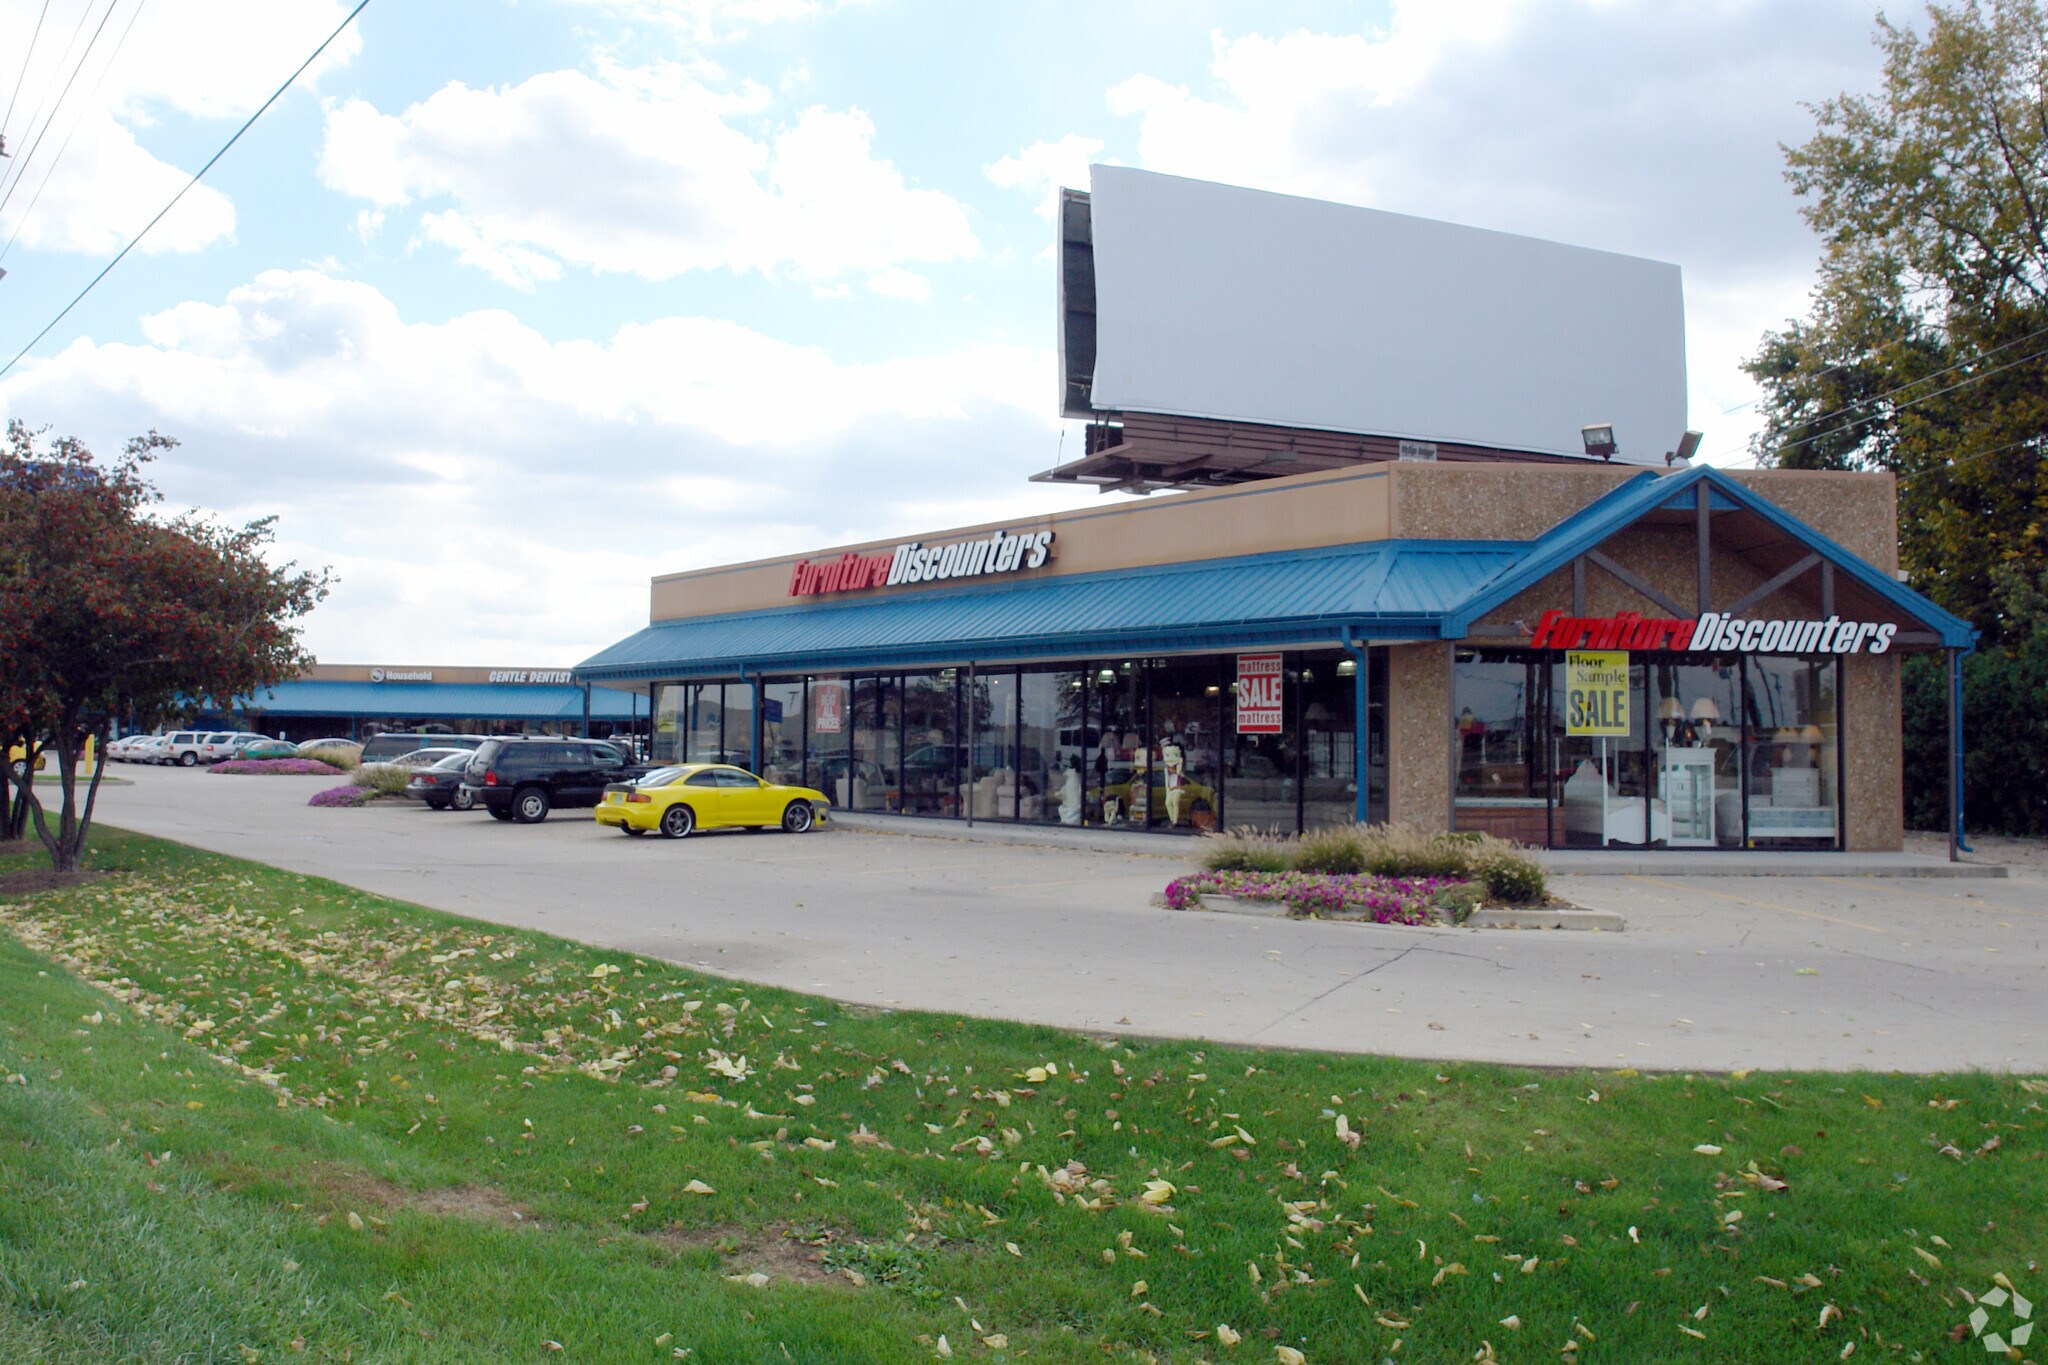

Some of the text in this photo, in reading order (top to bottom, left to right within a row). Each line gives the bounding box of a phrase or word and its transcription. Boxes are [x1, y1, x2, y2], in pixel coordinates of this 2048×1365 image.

[788, 530, 1053, 597] Furniture Discounters
[1531, 610, 1897, 654] Furniture Discounters
[1239, 662, 1280, 672] mattress
[1568, 654, 1605, 668] Floor
[386, 671, 433, 681] Household
[489, 671, 572, 683] GENTLE DENTIST
[1577, 669, 1625, 686] Sample
[1239, 677, 1281, 708] SALE
[1569, 689, 1625, 728] SALE
[1239, 713, 1280, 723] mattress
